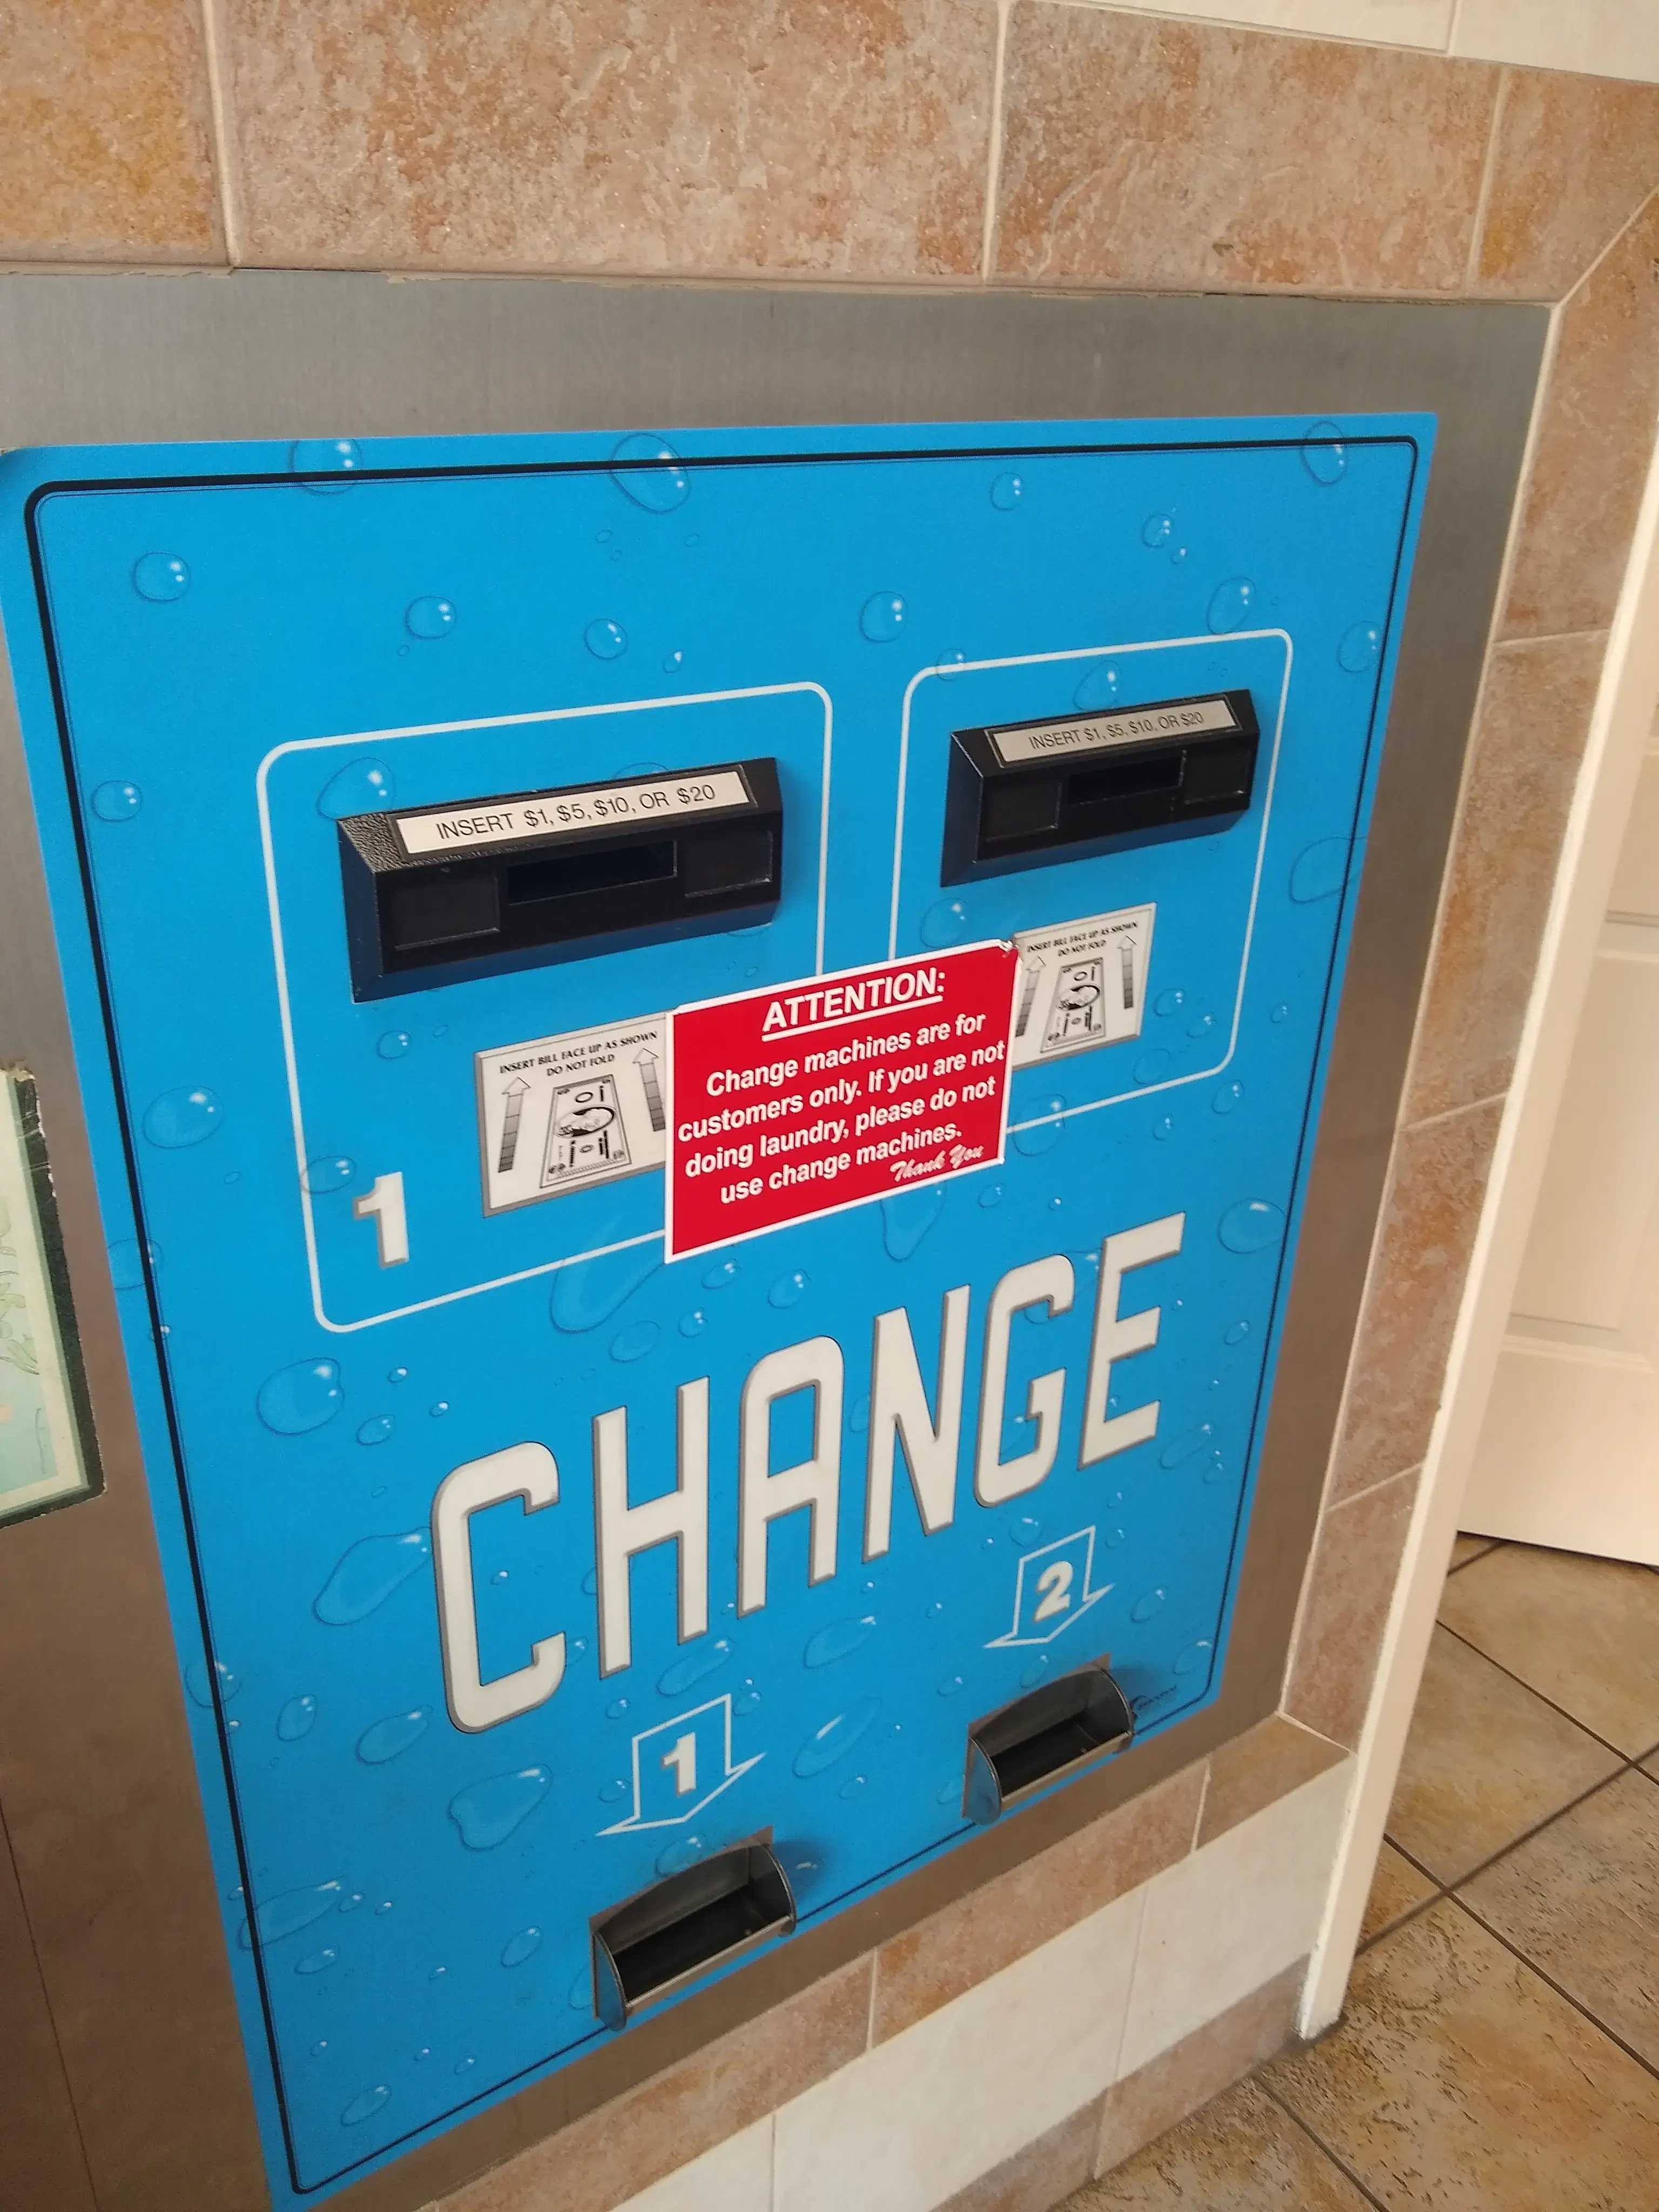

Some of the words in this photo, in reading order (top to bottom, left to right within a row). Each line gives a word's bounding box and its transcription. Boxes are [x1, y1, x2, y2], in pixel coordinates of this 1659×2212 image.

[1029, 729, 1081, 750] INSERT
[1084, 725, 1107, 743] $1,
[1158, 716, 1180, 730] OR
[1181, 711, 1204, 725] $20
[436, 812, 514, 839] INSERT
[524, 809, 554, 828] $1,
[557, 804, 592, 824] $5,
[594, 796, 636, 818] $10,
[640, 792, 670, 810] OR
[677, 784, 716, 806] $20
[761, 967, 946, 1032] ATTENTION:
[500, 1058, 536, 1074] INSERT
[538, 1054, 558, 1065] BILL
[561, 1047, 585, 1060] FACE
[588, 1043, 602, 1053] UP
[604, 1040, 618, 1050] AS
[619, 1030, 658, 1047] SHOWN
[547, 1065, 563, 1076] DO
[565, 1059, 587, 1071] NOT
[590, 1054, 615, 1067] FOLD
[706, 1058, 798, 1097] Change
[804, 1031, 912, 1073] machines
[916, 1023, 950, 1045] are
[954, 1013, 986, 1036] for
[678, 1093, 803, 1142] customers
[810, 1078, 862, 1109] only.
[868, 1069, 884, 1093] If
[887, 1063, 928, 1094] you
[933, 1053, 966, 1076] are
[971, 1040, 1005, 1067] not
[685, 1141, 753, 1178] doing
[760, 1119, 849, 1157] laundry,
[855, 1095, 926, 1136] please
[929, 1087, 956, 1111] do
[962, 1075, 996, 1102] not
[720, 1176, 763, 1203] use
[768, 1152, 851, 1190] change
[855, 1122, 962, 1165] machines.
[889, 1150, 946, 1182] Thank
[948, 1144, 984, 1169] You
[353, 1171, 410, 1269] 1
[431, 1211, 1186, 1734] CHANGE
[1033, 1560, 1074, 1623] 2
[661, 1731, 698, 1798] 1
